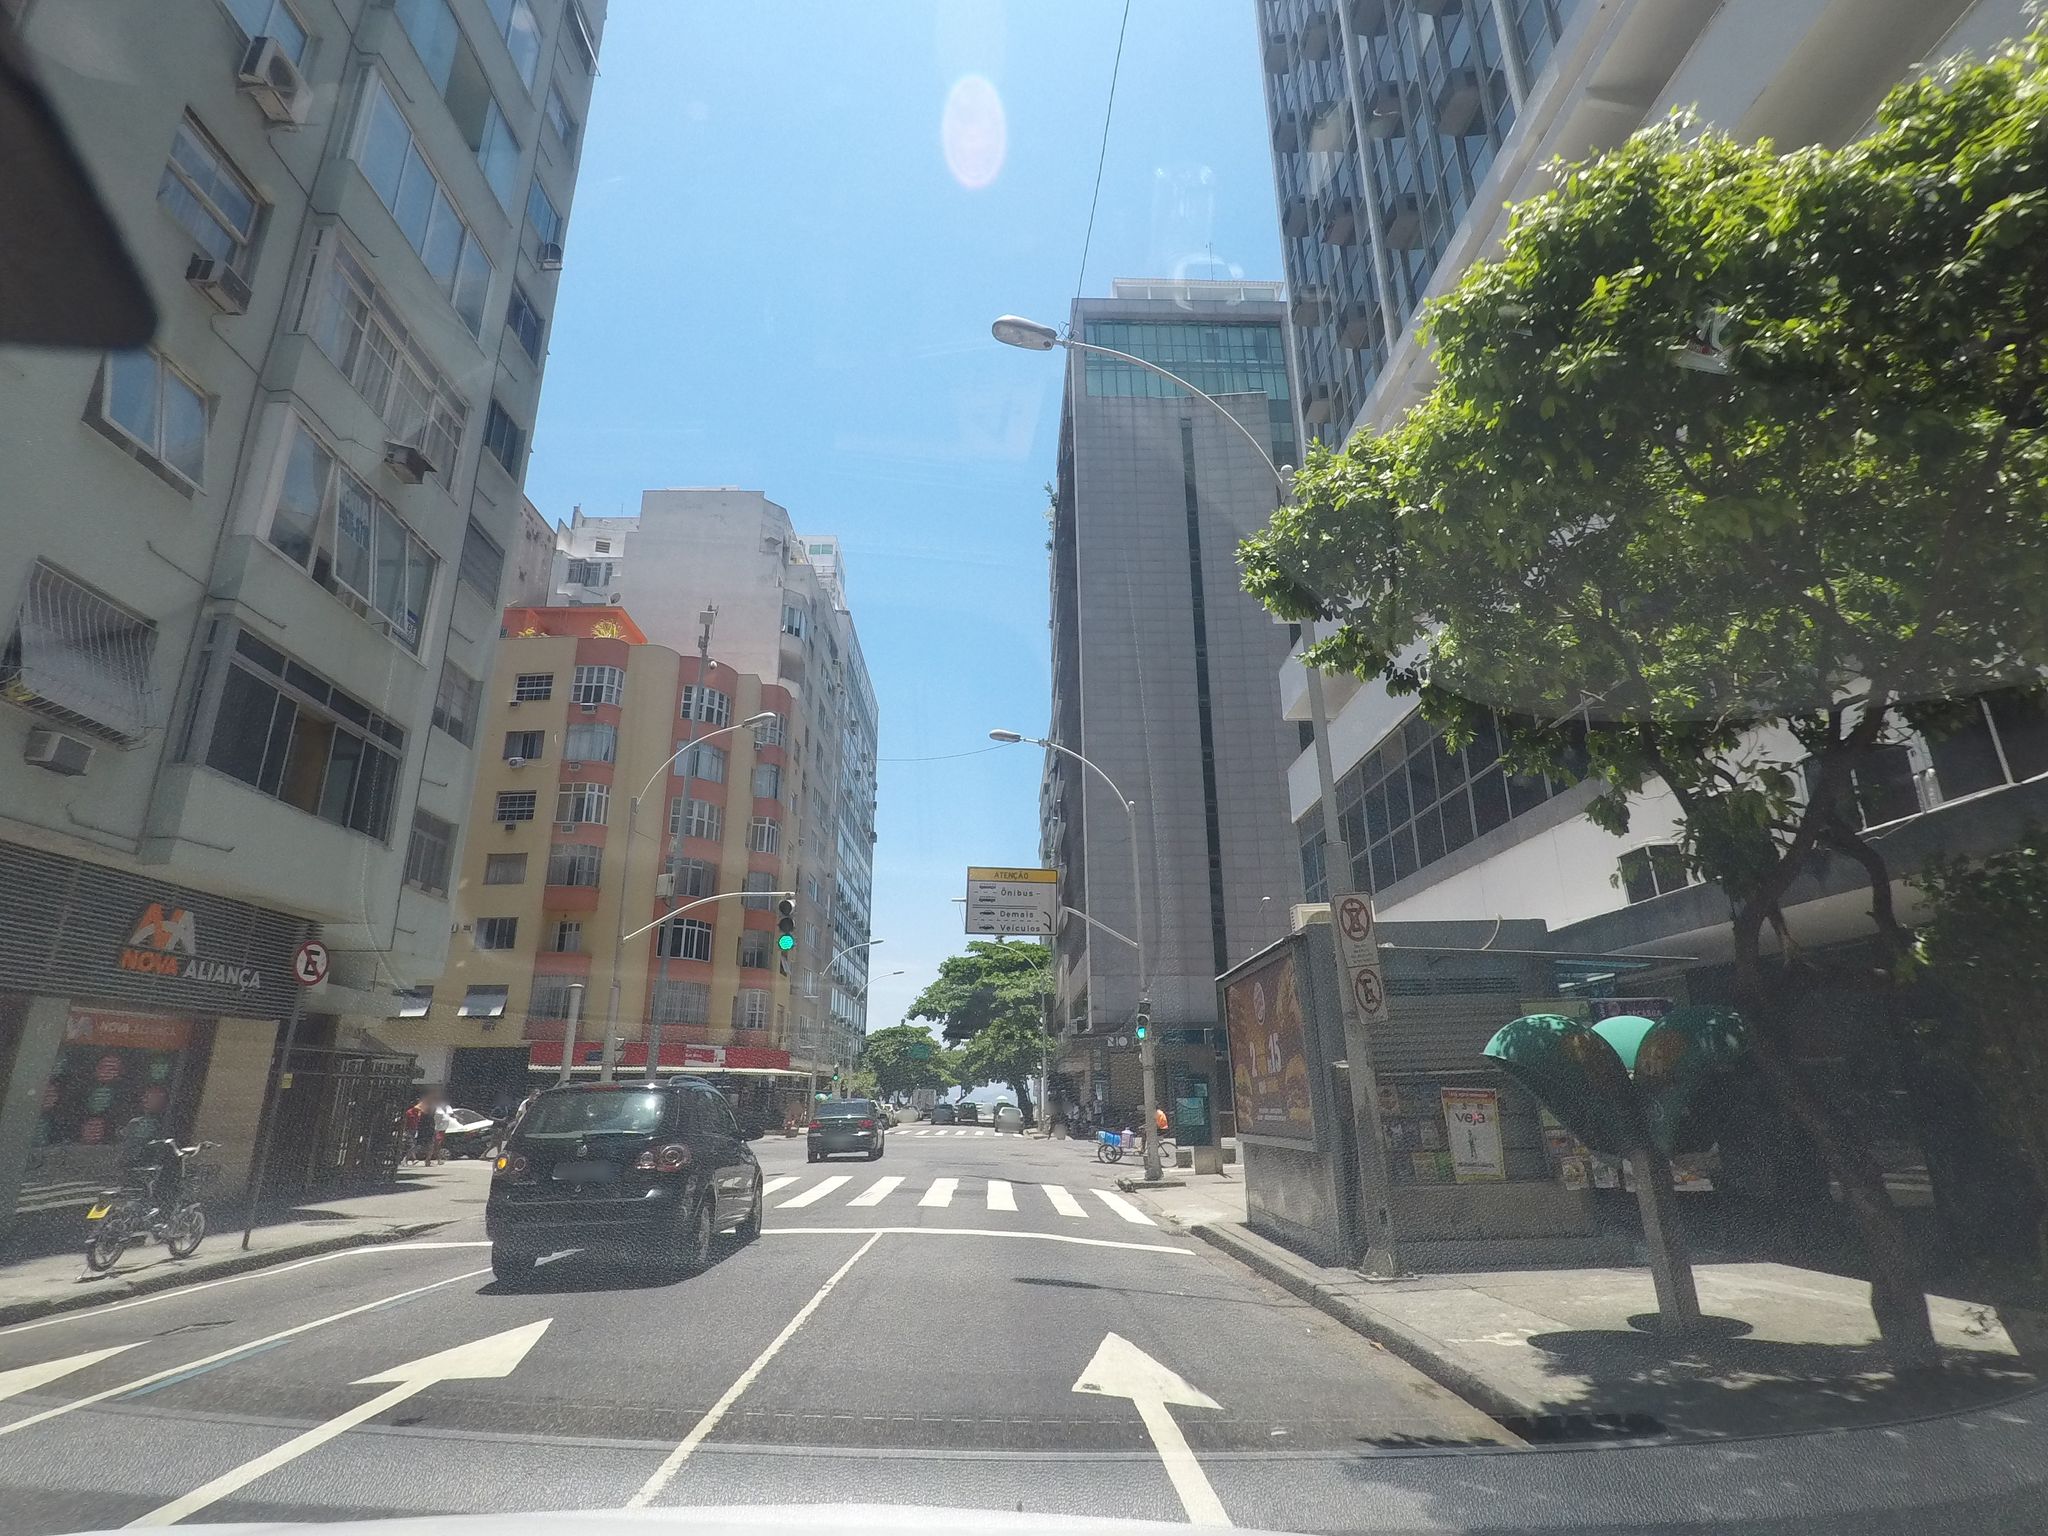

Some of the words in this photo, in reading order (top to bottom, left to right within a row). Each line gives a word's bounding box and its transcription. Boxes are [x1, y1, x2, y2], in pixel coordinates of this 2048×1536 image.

[994, 870, 1029, 880] ATENÇÃO
[1000, 887, 1034, 897] Ônibus
[1000, 910, 1034, 918] Demais
[1000, 924, 1041, 932] Veículos
[120, 949, 178, 976] NOVA
[182, 959, 261, 991] ALIANÇA
[1455, 1112, 1486, 1125] veja
